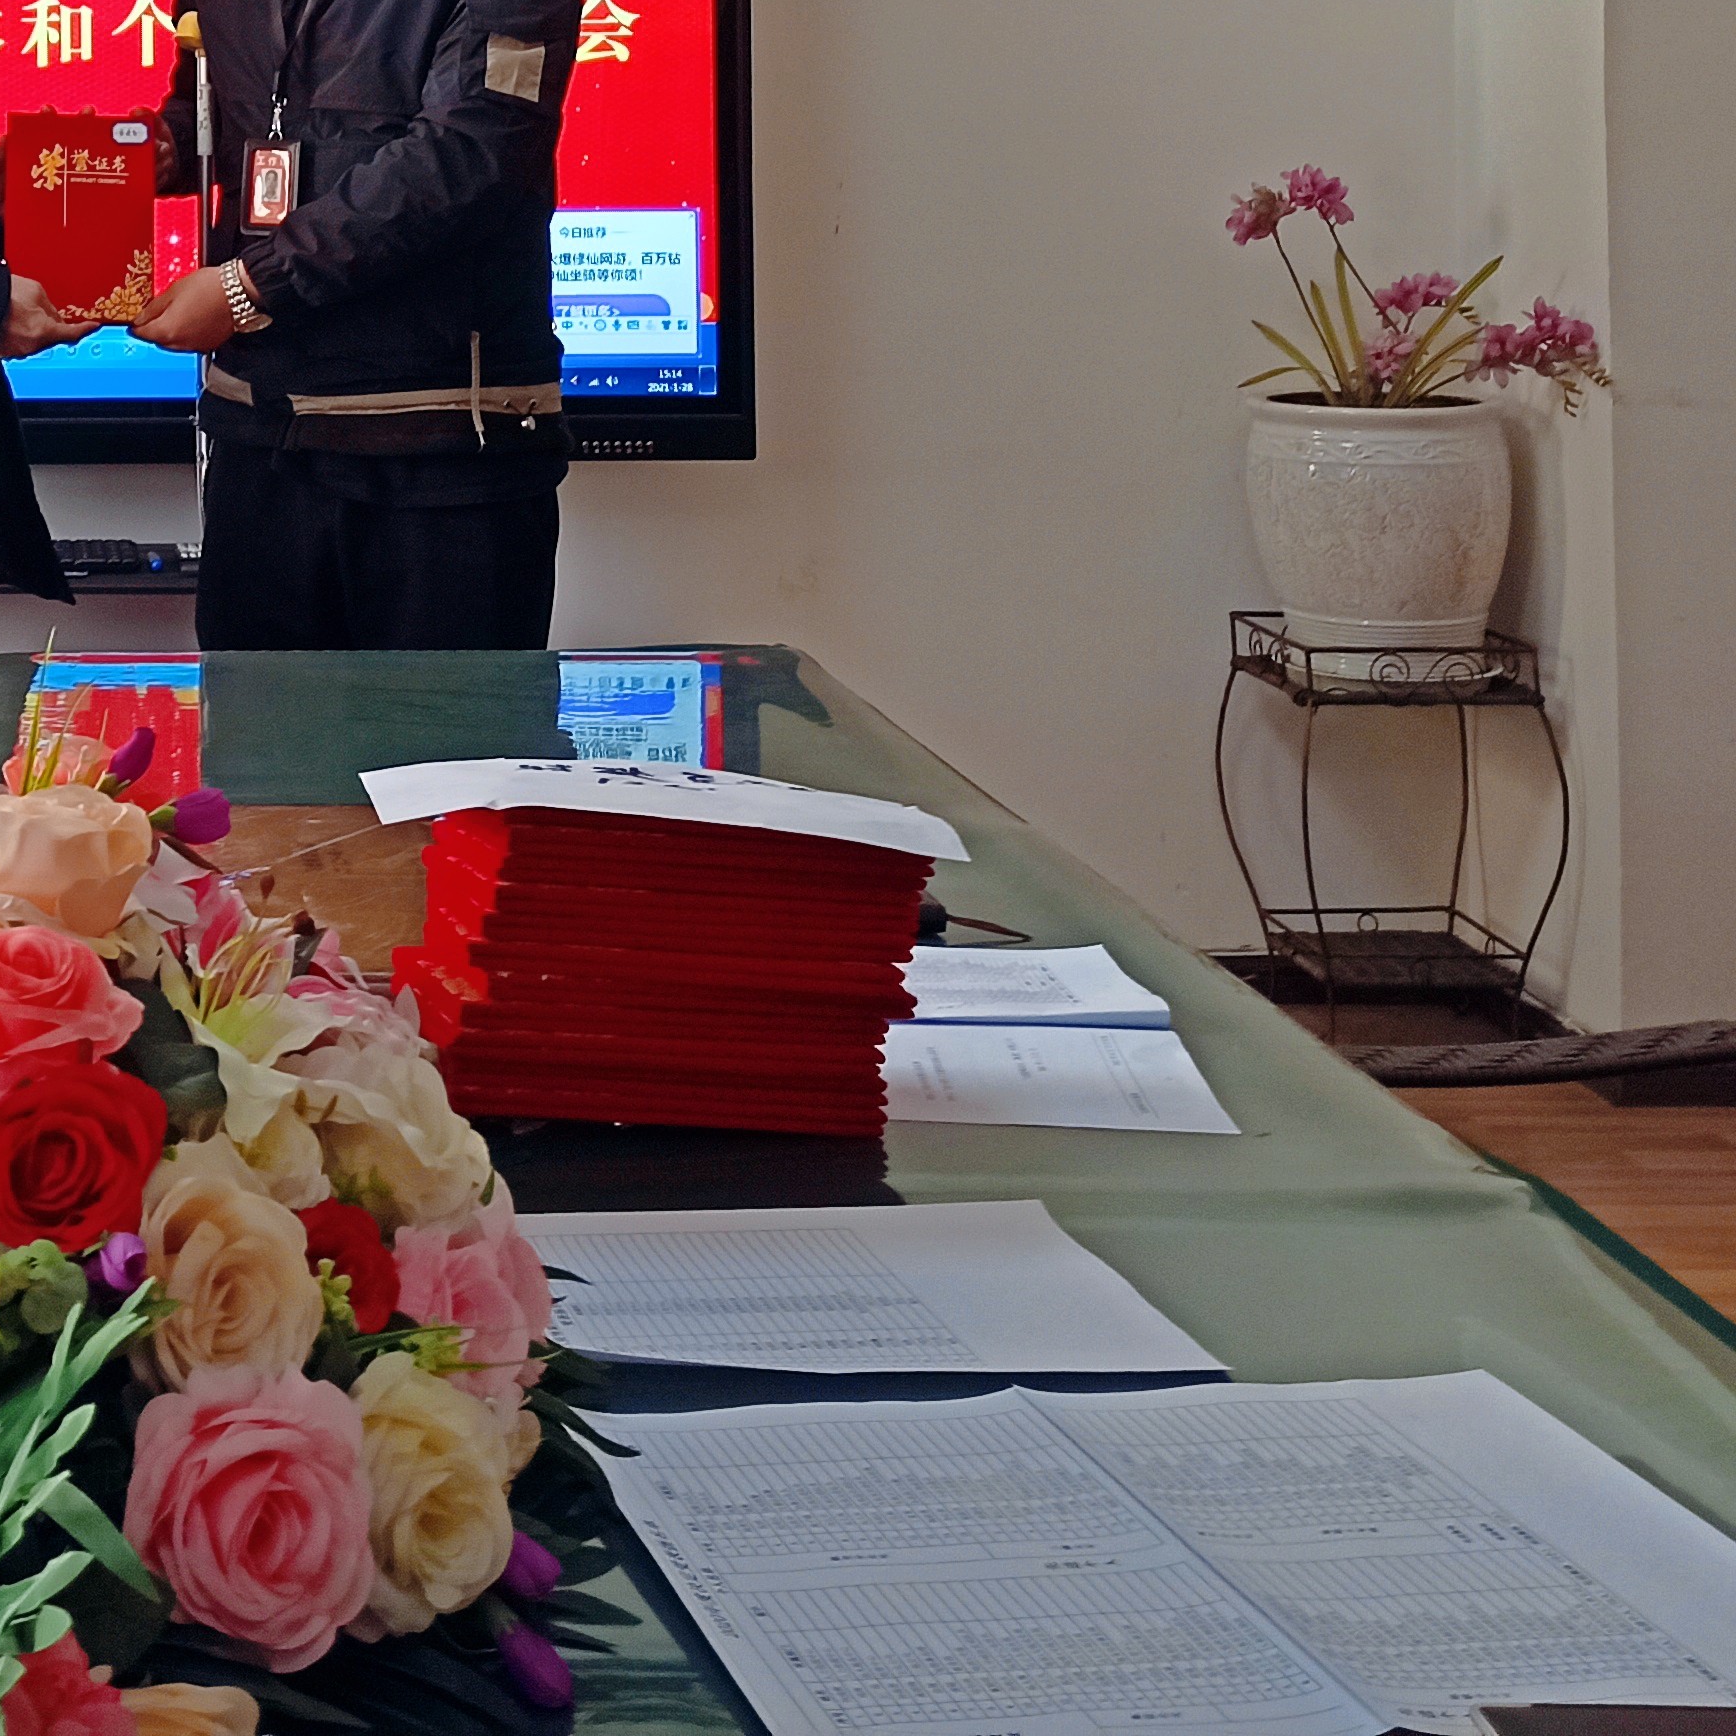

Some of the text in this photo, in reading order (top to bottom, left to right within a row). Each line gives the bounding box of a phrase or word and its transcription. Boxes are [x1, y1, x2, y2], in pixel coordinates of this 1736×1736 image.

[30, 142, 127, 192] 荣誉证书
[659, 368, 683, 379] 15:14
